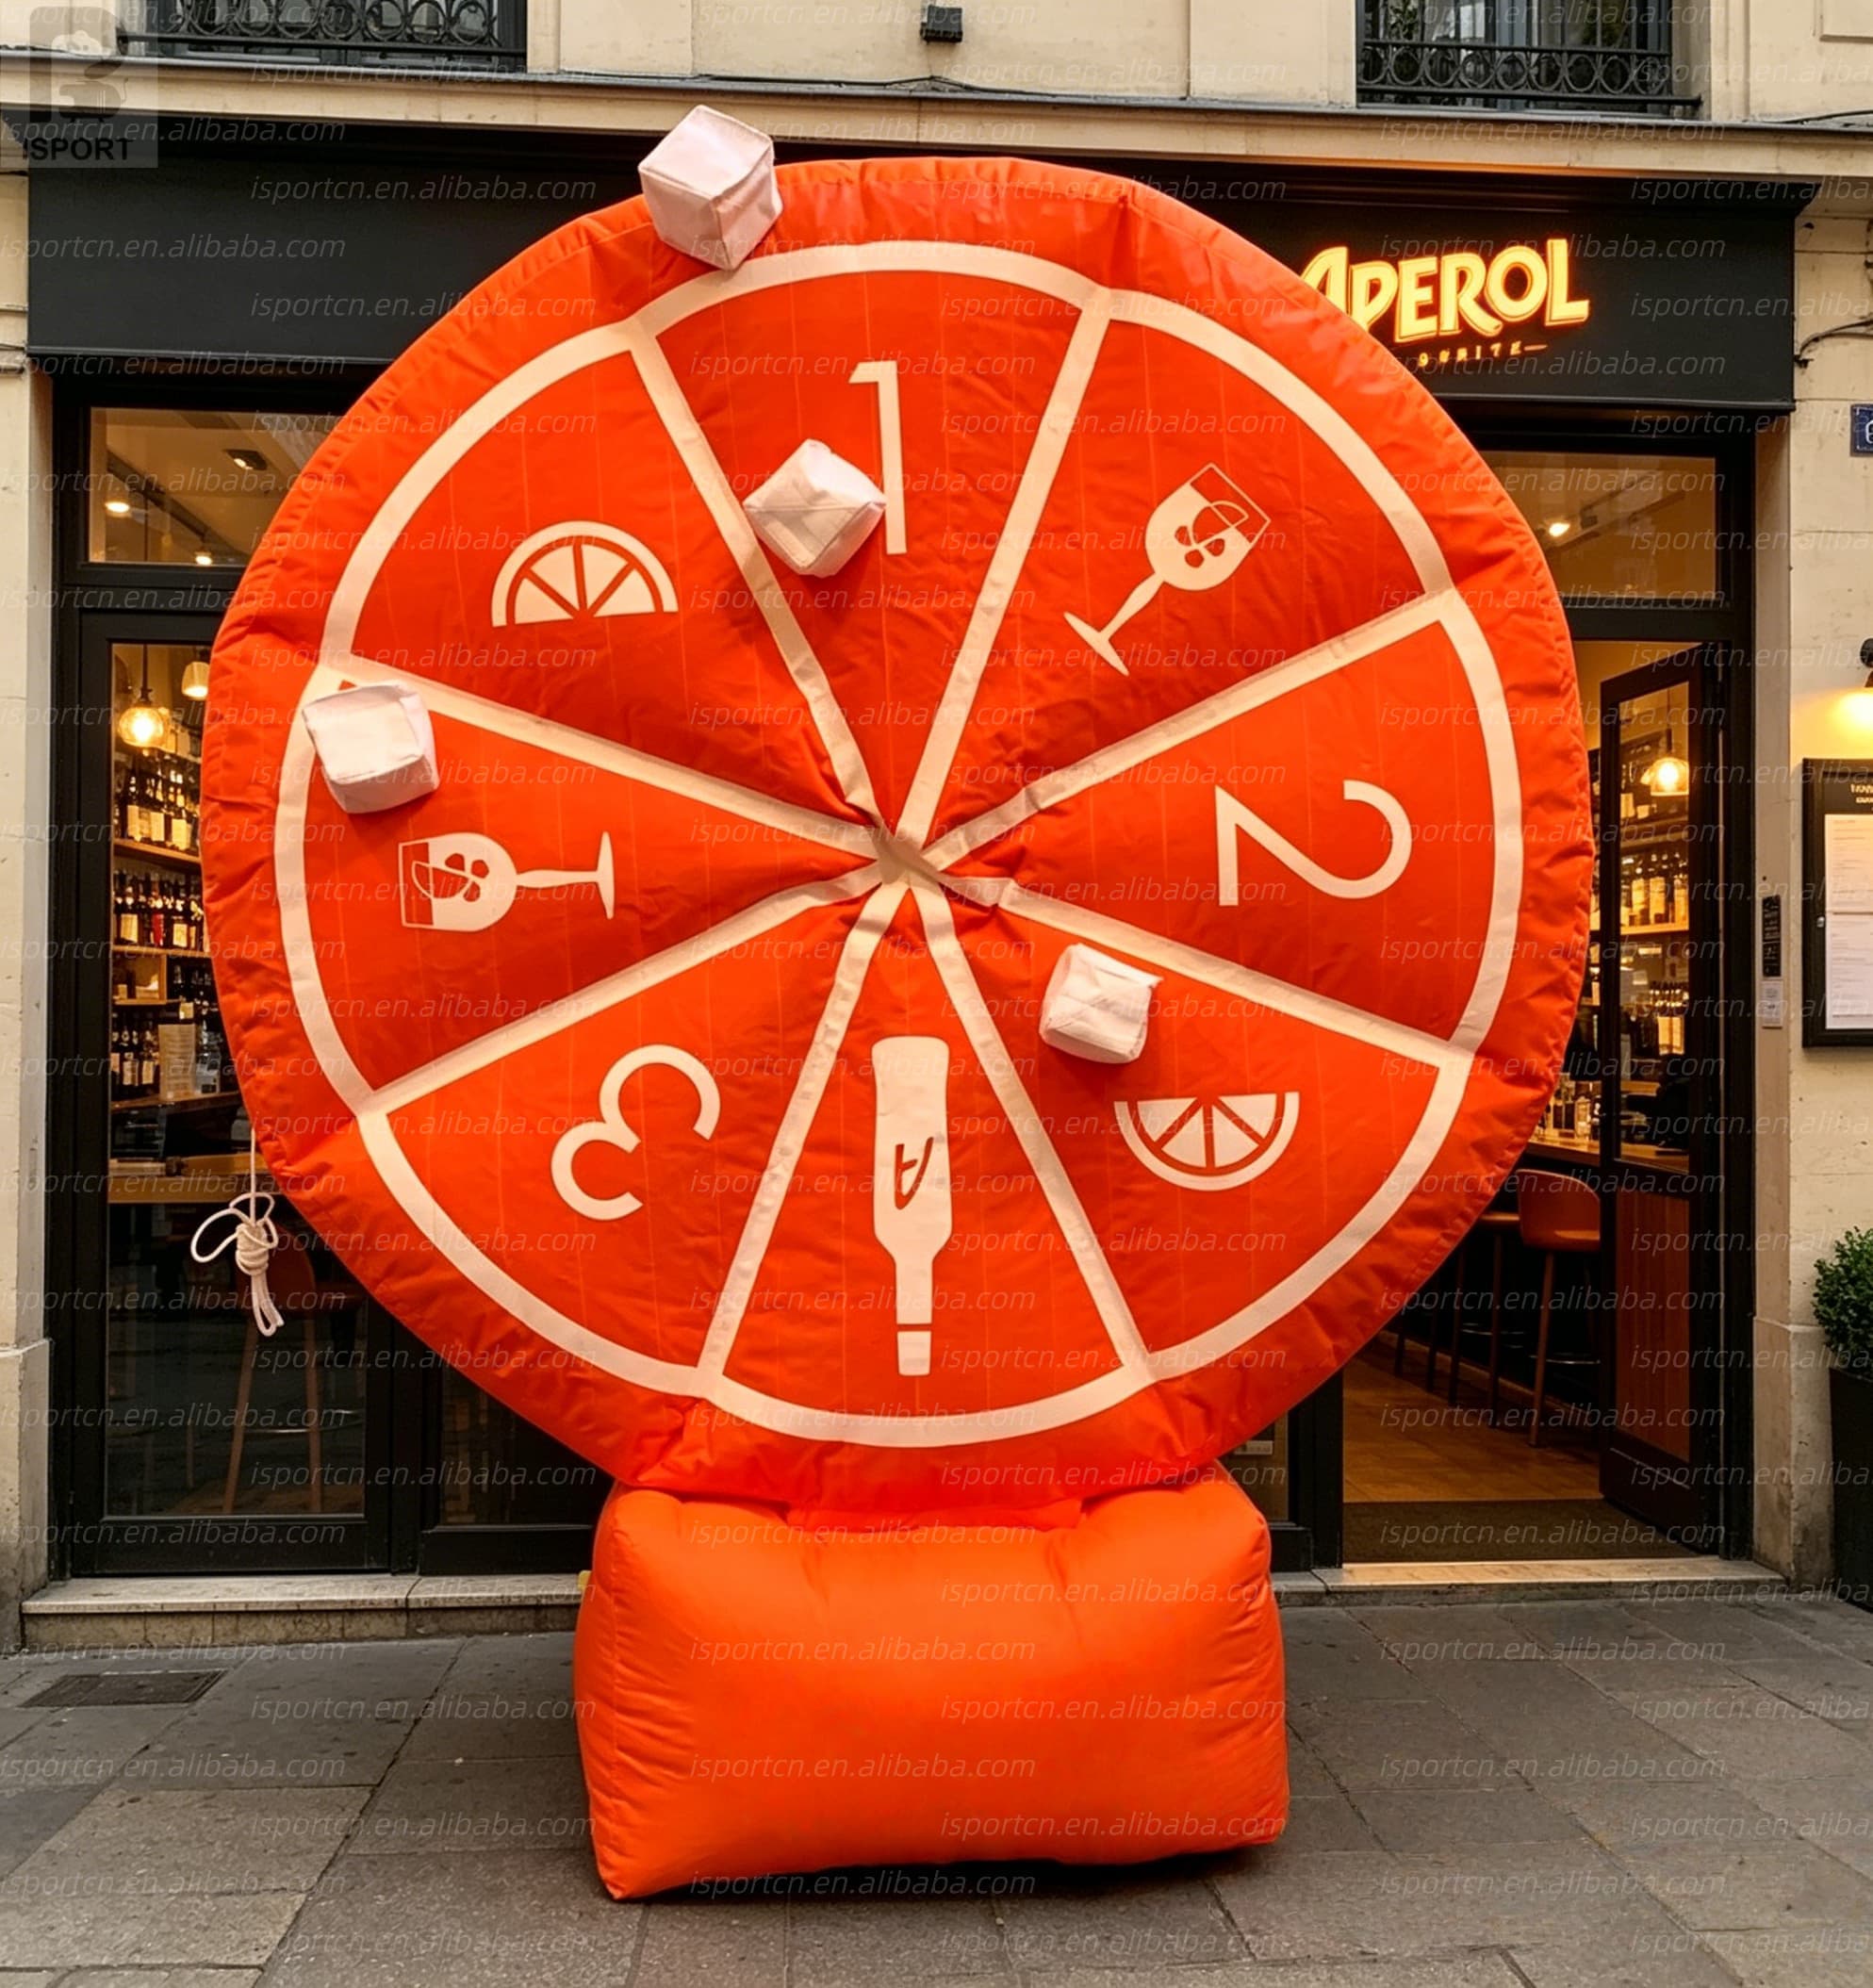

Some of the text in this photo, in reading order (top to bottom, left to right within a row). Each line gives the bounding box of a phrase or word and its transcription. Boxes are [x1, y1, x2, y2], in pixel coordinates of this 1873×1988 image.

[1300, 238, 1590, 342] APEROL
[847, 360, 908, 554] 1
[1215, 780, 1412, 906] 2
[551, 1044, 720, 1220] 3
